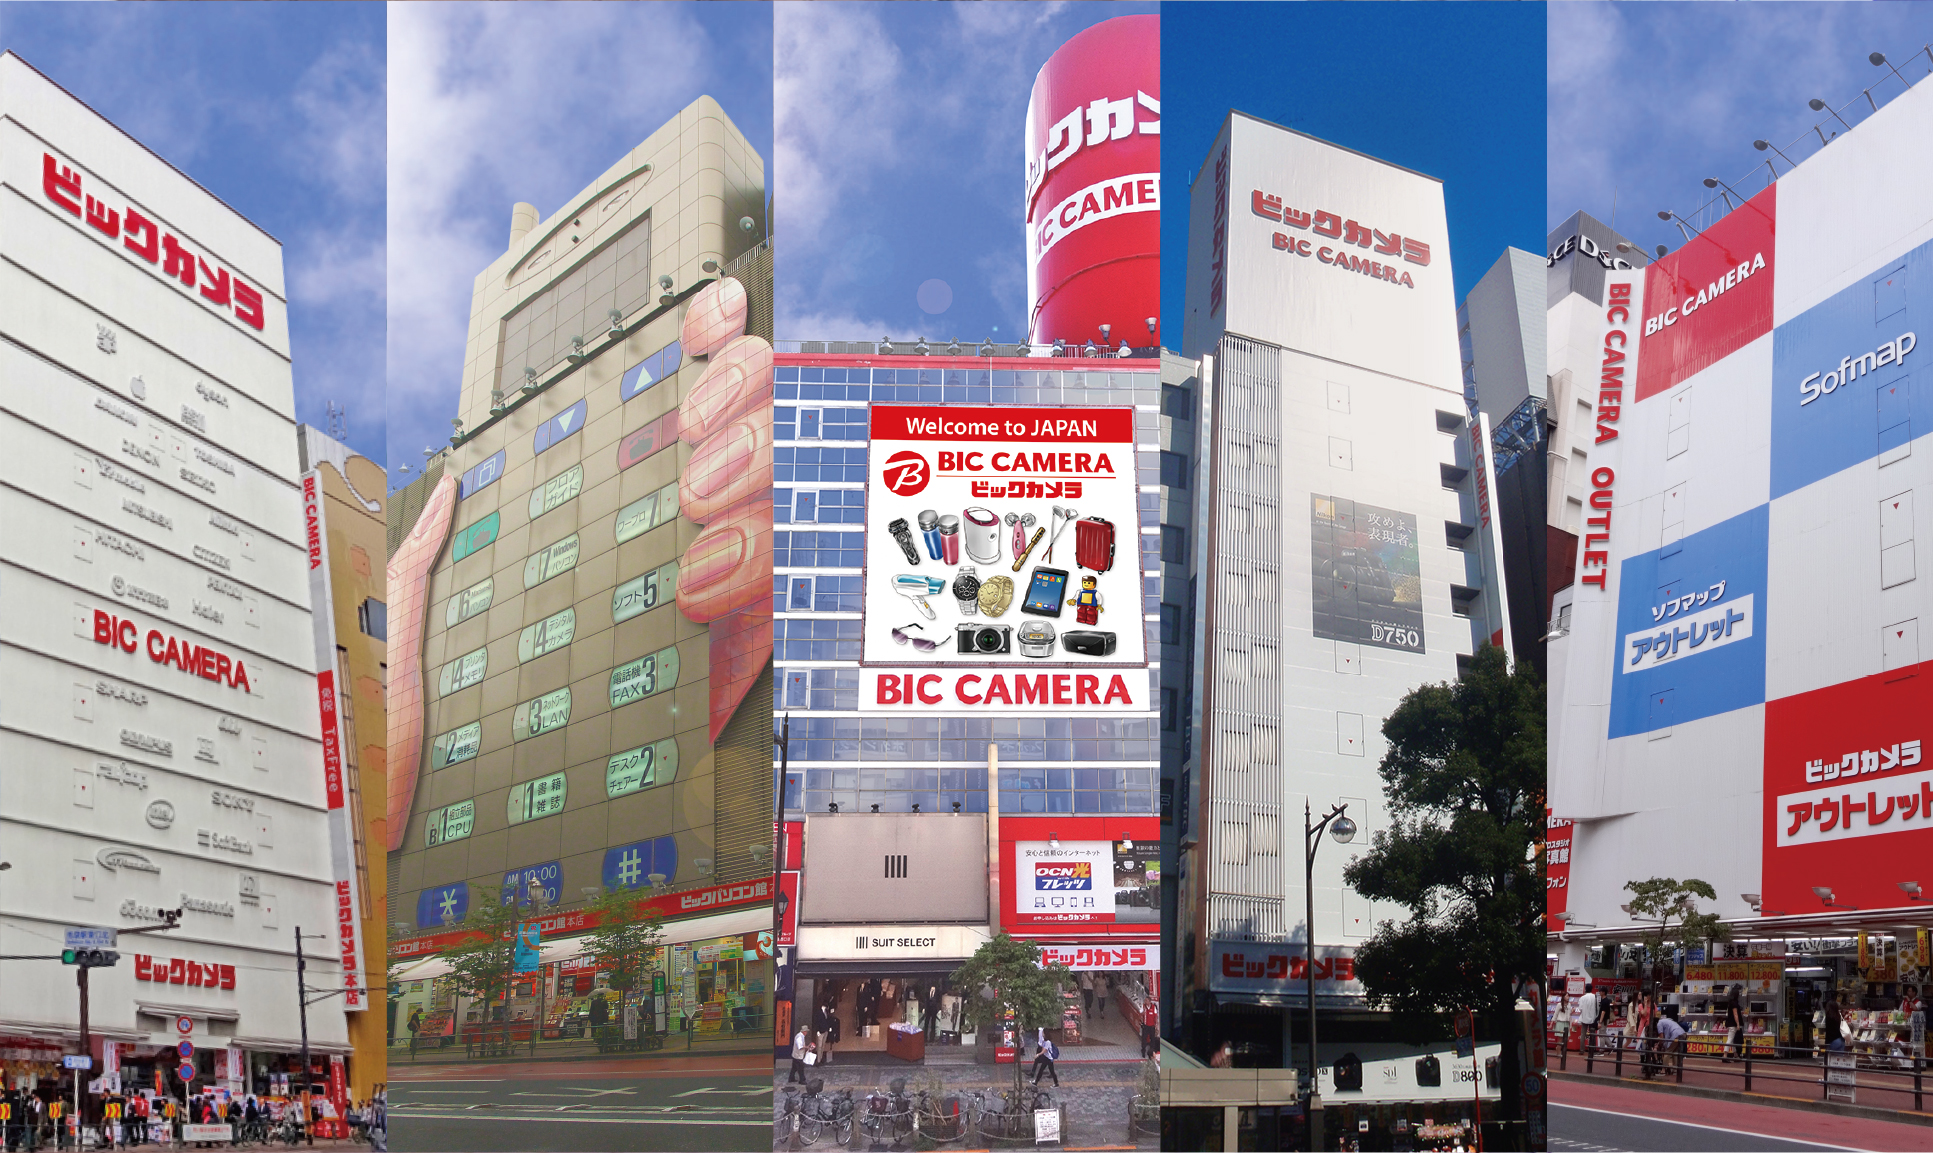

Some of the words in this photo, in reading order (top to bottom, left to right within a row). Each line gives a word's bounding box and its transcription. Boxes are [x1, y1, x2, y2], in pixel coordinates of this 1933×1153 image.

[1058, 178, 1160, 230] CAME
[1251, 188, 1431, 267] ビックカメラ
[42, 151, 265, 331] ビックカメラ
[1271, 231, 1313, 259] BIC
[1316, 245, 1415, 290] CAMERA
[1606, 282, 1632, 325] BIC
[1645, 306, 1678, 338] BIC
[1681, 252, 1767, 318] CAMERA
[1800, 331, 1918, 407] Sofmap
[1594, 329, 1628, 445] CAMERA
[905, 417, 999, 436] Welcome
[1003, 419, 1026, 436] to
[1030, 418, 1098, 438] JAPAN
[1471, 423, 1480, 453] BIC
[937, 451, 984, 473] BIC
[991, 452, 1116, 474] CAMERA
[303, 477, 316, 503] BIC
[546, 467, 580, 493] フロア
[971, 480, 1083, 499] ビックカメラ
[1474, 454, 1491, 530] CAMERA
[547, 482, 579, 511] ガイド
[617, 508, 646, 533] ワープロ
[645, 492, 660, 529] 7
[1316, 511, 1335, 520] Nikon
[1367, 512, 1413, 534] 攻めよ、
[305, 504, 322, 571] CAMERA
[1367, 527, 1414, 549] 表現者。
[1580, 466, 1616, 591] OUTLET
[552, 538, 578, 558] Windows
[539, 547, 552, 581] 7
[551, 552, 578, 572] パソコン
[614, 591, 643, 611] ソフト
[643, 571, 657, 609] 5
[1652, 579, 1727, 622] ソフマップ
[459, 589, 471, 620] 6
[469, 596, 491, 614] パソコン
[548, 611, 574, 631] デジタル
[535, 619, 548, 654] 4
[548, 628, 573, 648] カメラ
[1371, 623, 1420, 648] D750
[1631, 607, 1744, 666] アウトレット
[94, 608, 138, 654] BIC
[146, 629, 250, 693] CAMERA
[453, 660, 465, 690] 4
[464, 666, 486, 683] メモリ
[612, 665, 641, 686] 電話機
[641, 655, 656, 693] 3
[542, 691, 570, 711] ネットワーク
[612, 682, 640, 704] FAX
[876, 673, 944, 706] BIC
[954, 673, 1133, 706] CAMERA
[530, 699, 542, 735] 3
[542, 707, 568, 730] LAN
[456, 725, 480, 742] メディア
[446, 731, 457, 765] 2
[609, 754, 640, 774] デスク
[638, 746, 654, 788] 2
[1805, 739, 1922, 784] ビックカメラ
[609, 775, 640, 793] チェアー
[525, 783, 534, 819] 1
[428, 827, 438, 846] B
[440, 807, 449, 842] 1
[448, 820, 472, 838] CPU
[1025, 849, 1101, 858] 安心と信頼のインターネット
[507, 873, 519, 885] AM
[523, 865, 557, 884] 10:00
[1041, 879, 1086, 890] フレッツ
[336, 879, 359, 1006] ビックカメラ本店
[872, 938, 895, 949] SUIT
[897, 937, 936, 948] SELECT
[1723, 944, 1748, 959] 決算
[1876, 937, 1883, 957] 決算
[1042, 948, 1147, 967] ビックカメラ
[1222, 953, 1355, 982] ビックカメラ
[135, 953, 236, 991] ビックカメラ
[1452, 1070, 1483, 1083] D800
[1525, 1078, 1540, 1093] 50
